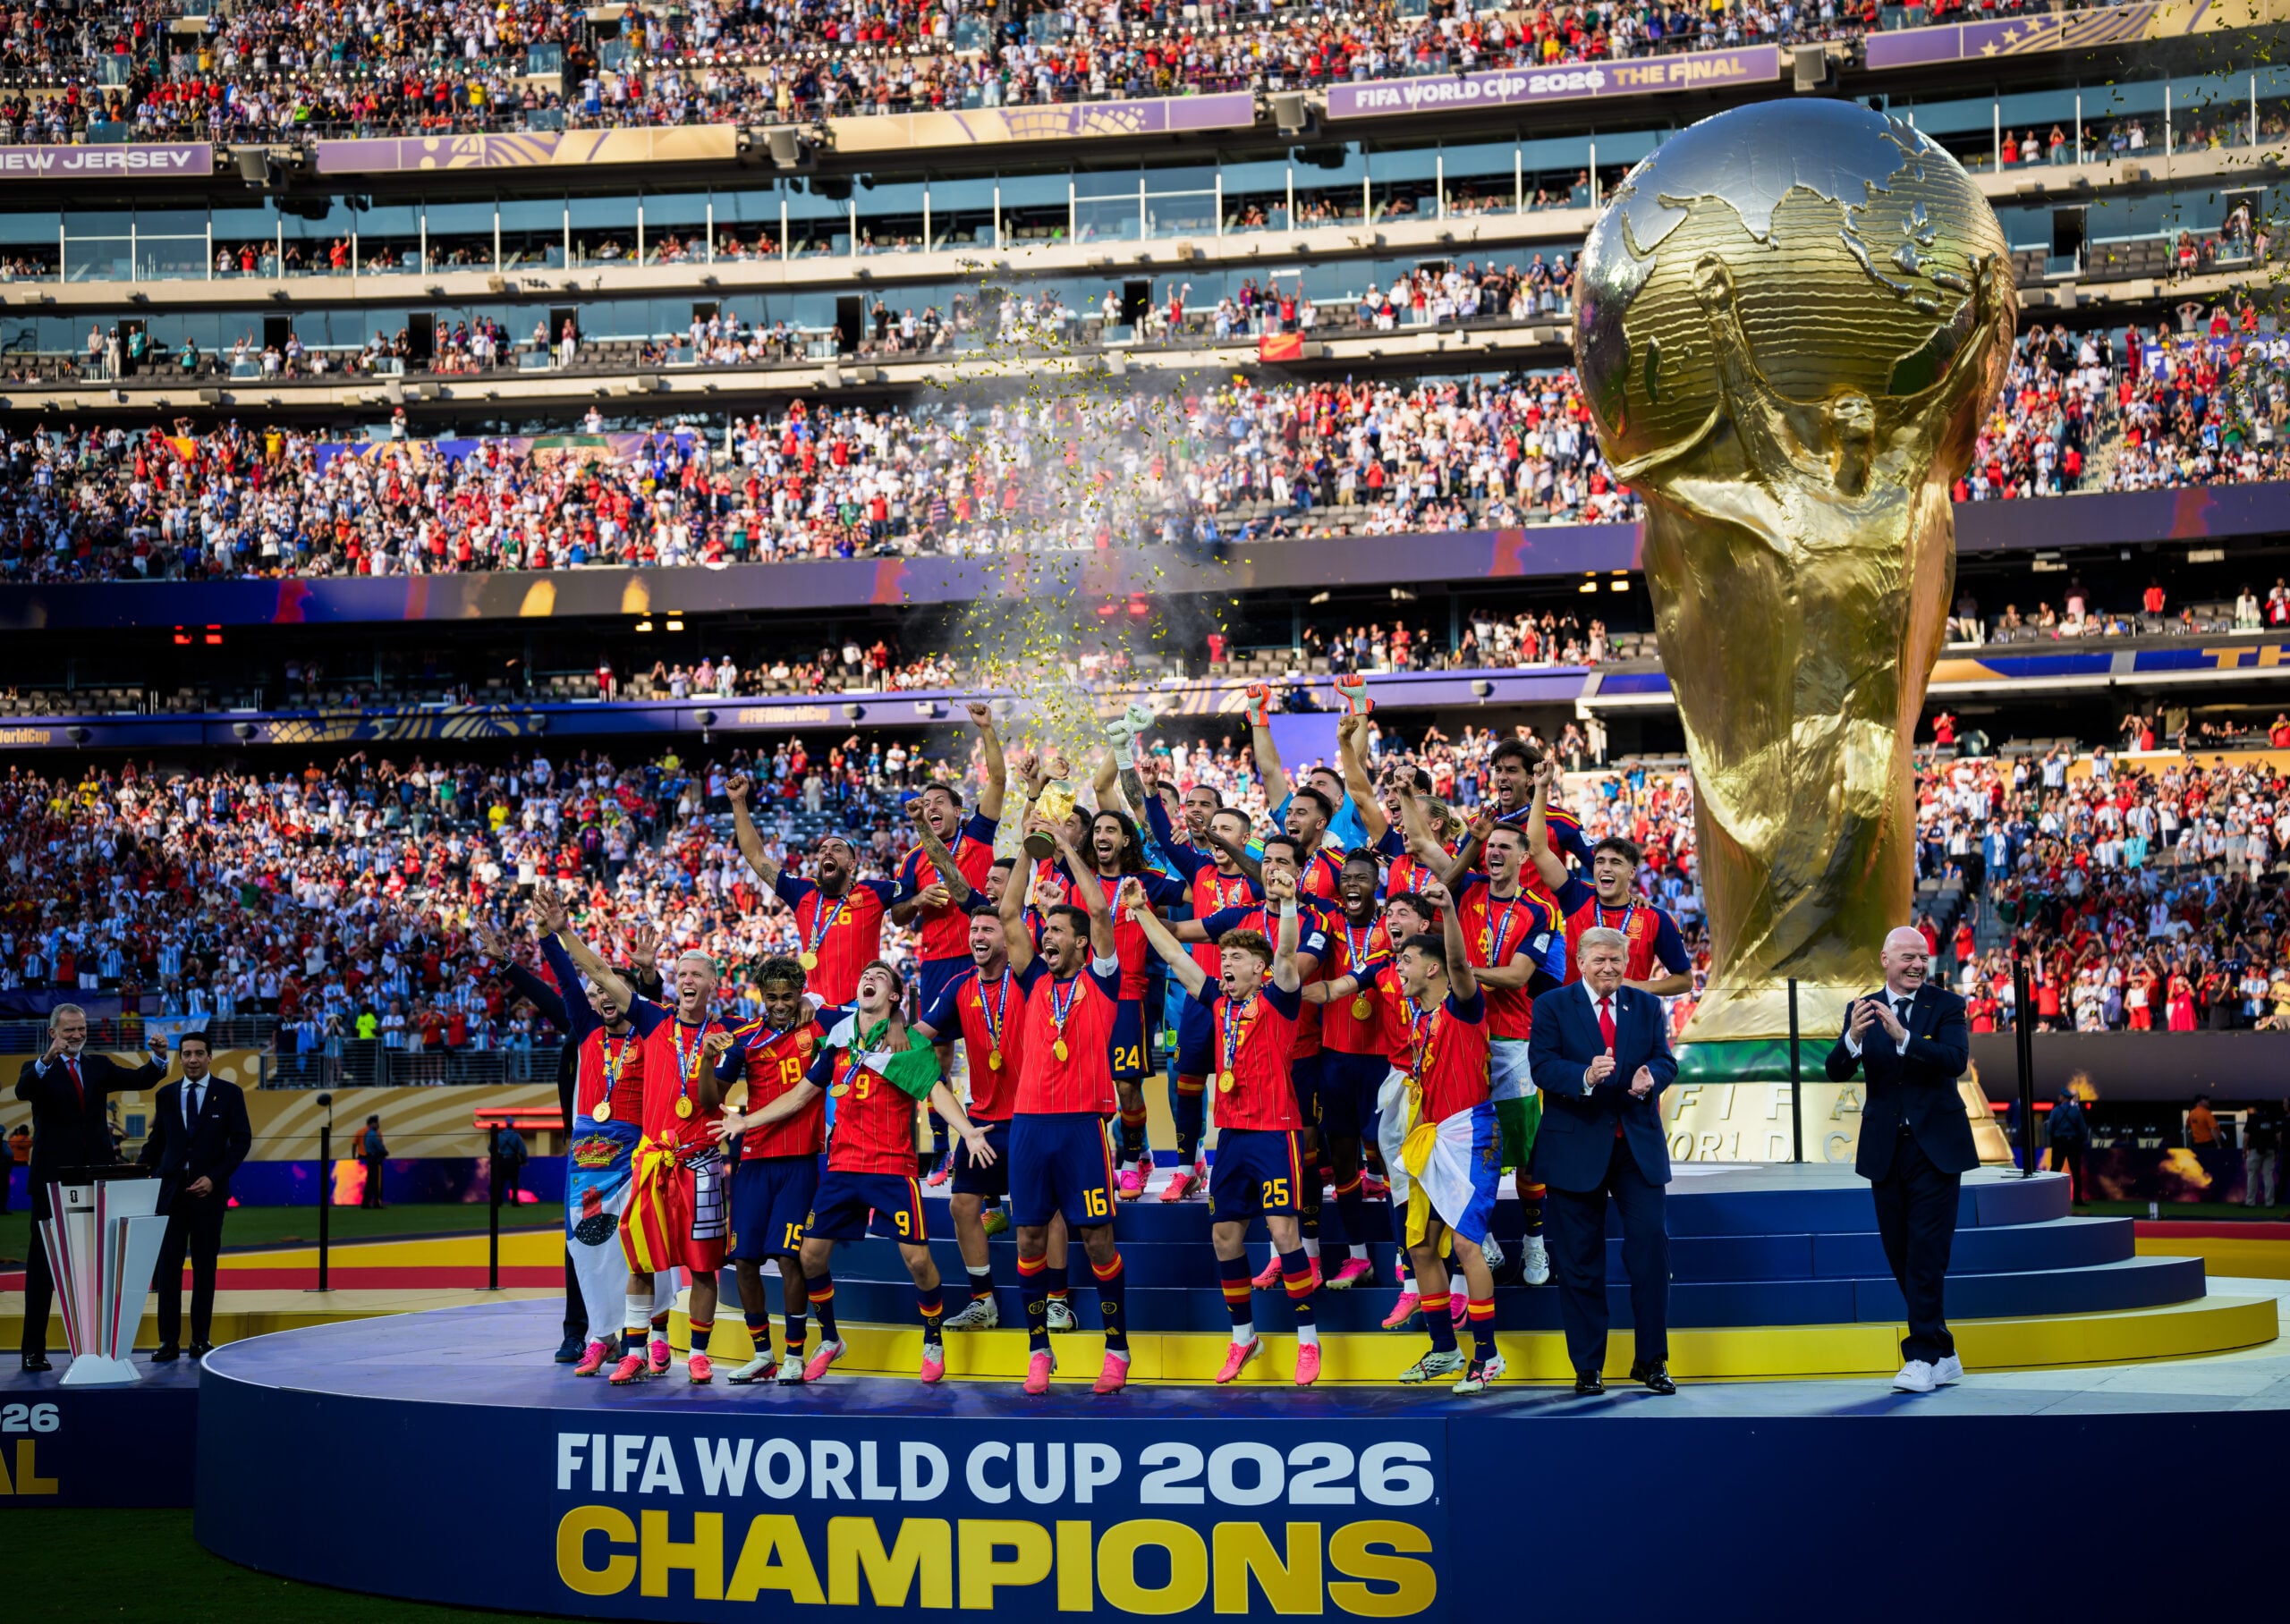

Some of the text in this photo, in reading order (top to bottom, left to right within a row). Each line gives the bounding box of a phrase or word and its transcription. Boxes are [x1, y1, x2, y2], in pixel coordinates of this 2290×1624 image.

[1355, 56, 1747, 108] FIFA WORLD CUP 2026 THE FINAL
[0, 150, 191, 169] EW JERSEY
[739, 706, 830, 723] #FIFAWorldCup
[0, 728, 50, 744] orldCup
[826, 905, 852, 926] 26
[779, 1057, 802, 1084] 19
[1115, 1045, 1141, 1071] 24
[856, 1074, 869, 1099] 9
[1083, 1188, 1107, 1217] 16
[1262, 1178, 1289, 1208] 25
[895, 1211, 910, 1236] 9
[0, 1403, 60, 1433] 26
[0, 1439, 58, 1494] L
[557, 1433, 684, 1495] FIFA
[693, 1437, 950, 1501] WORLD
[965, 1441, 1122, 1504] CUP
[1139, 1442, 1435, 1506] 2026
[556, 1505, 1438, 1617] CHAMPIONS
